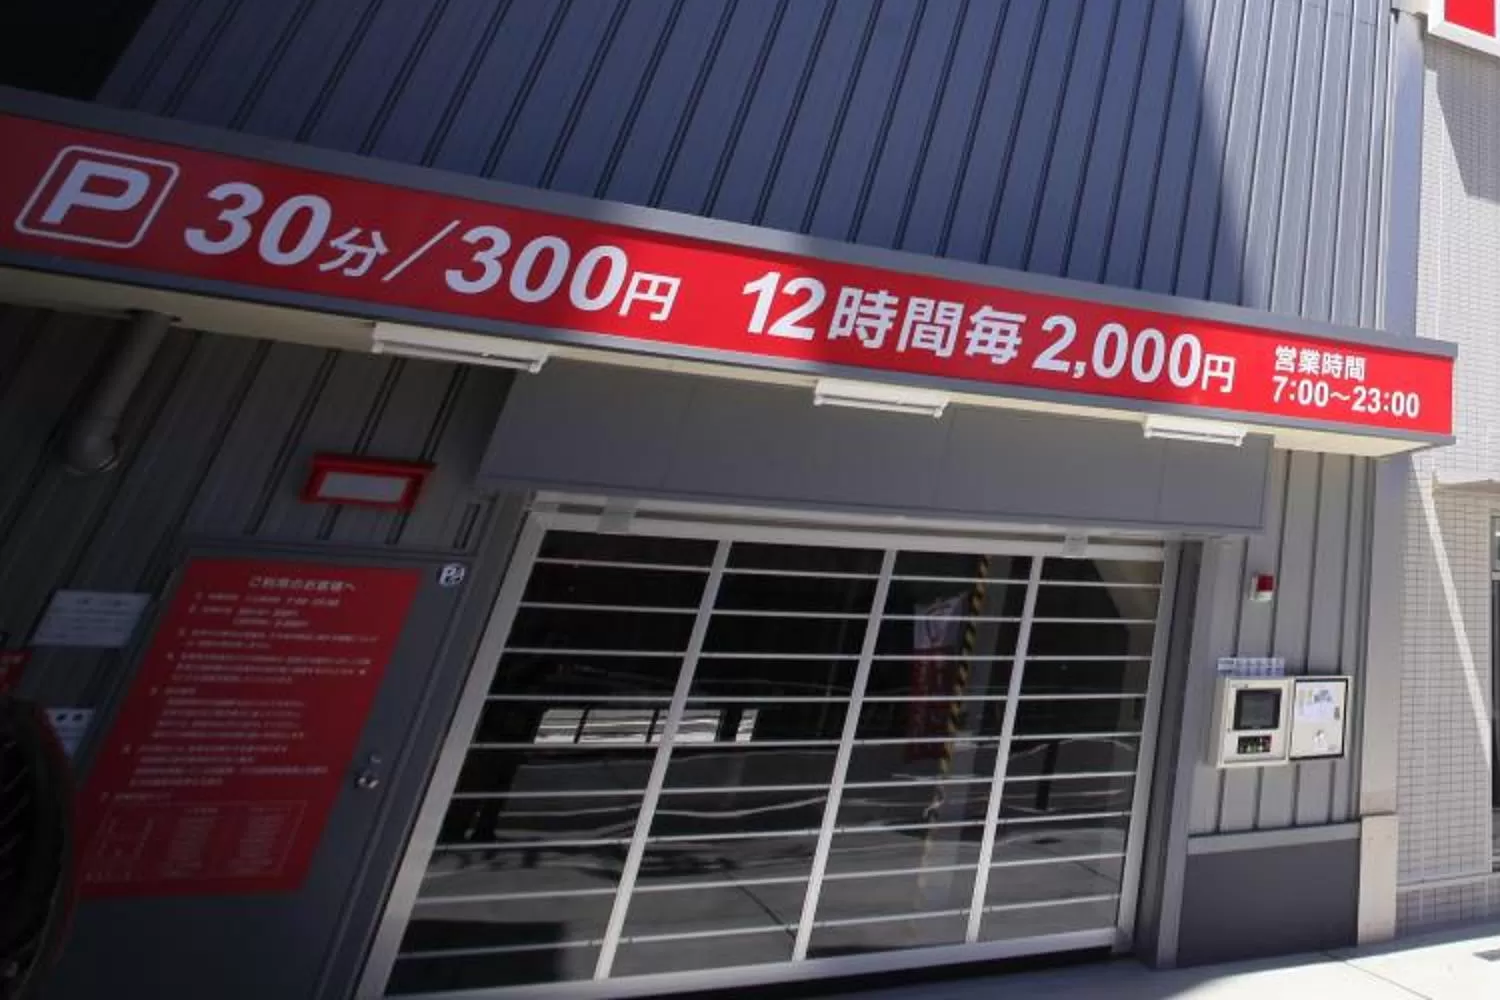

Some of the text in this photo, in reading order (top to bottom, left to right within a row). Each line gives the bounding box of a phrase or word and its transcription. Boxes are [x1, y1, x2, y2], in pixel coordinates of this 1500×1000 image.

[40, 159, 151, 225] P
[741, 270, 1028, 364] 12時間毎
[1031, 314, 1237, 395] 2,000円
[1274, 345, 1367, 382] 営業時間
